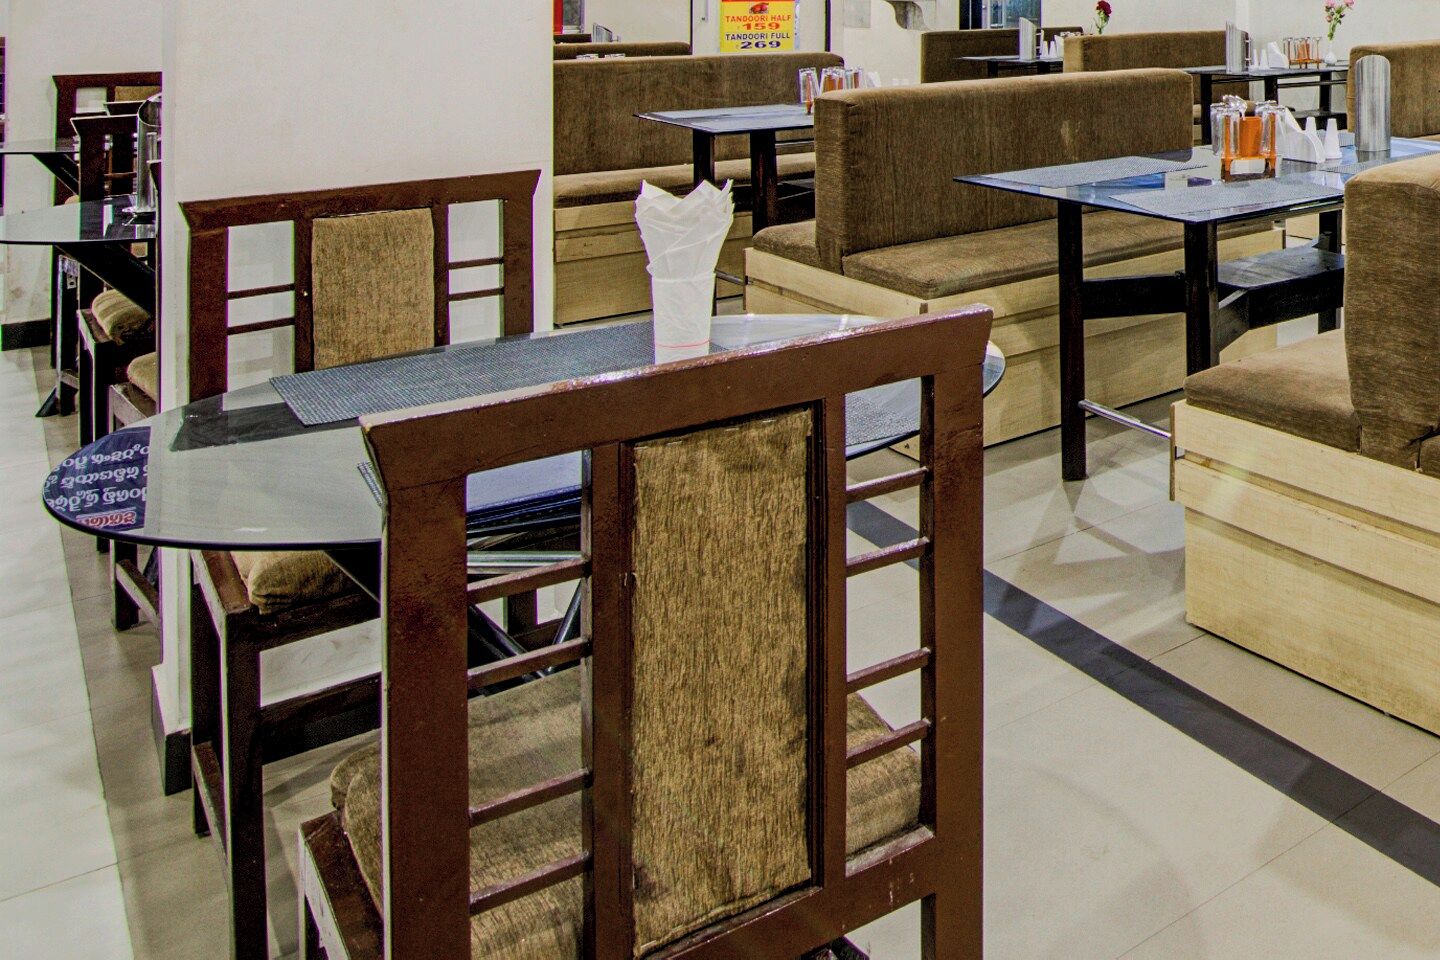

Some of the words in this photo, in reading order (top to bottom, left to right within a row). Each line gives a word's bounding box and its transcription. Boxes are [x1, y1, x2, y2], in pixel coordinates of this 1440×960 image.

[725, 15, 769, 23] TANDOORI
[770, 14, 791, 22] HALF
[725, 33, 768, 41] TANDOORI
[770, 32, 790, 40] FULL
